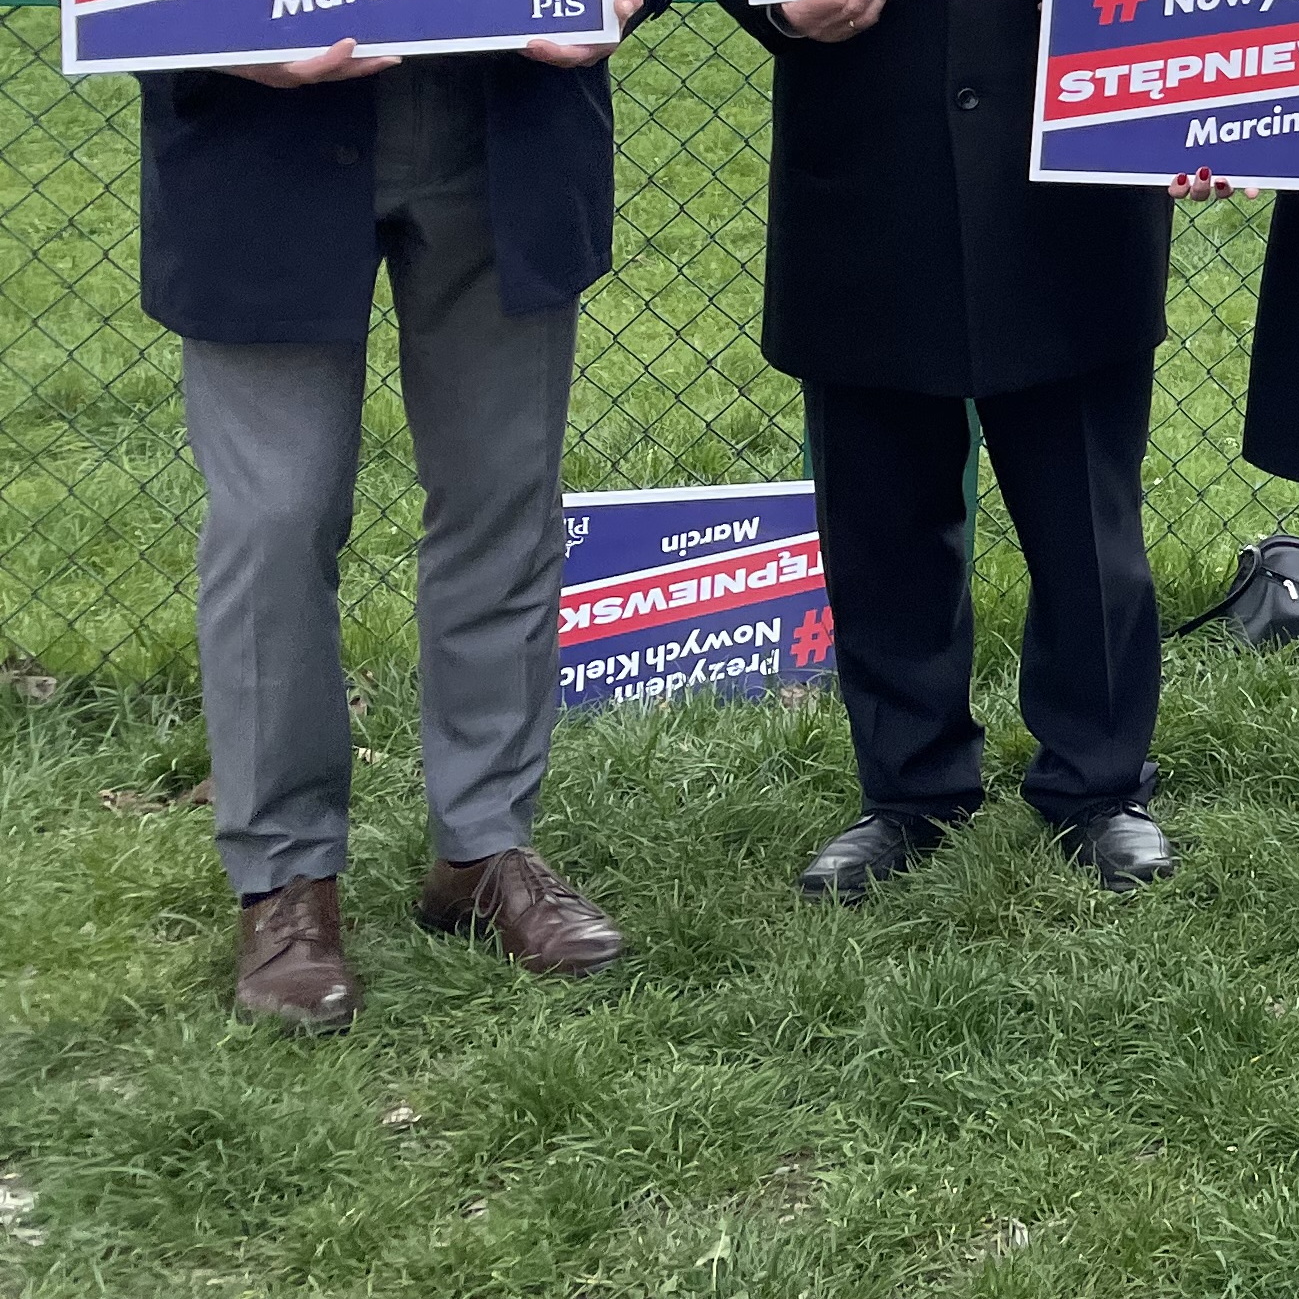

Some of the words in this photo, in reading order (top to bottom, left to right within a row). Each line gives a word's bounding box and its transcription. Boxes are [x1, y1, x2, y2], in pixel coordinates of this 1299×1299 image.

[661, 516, 760, 557] Marcin
[559, 551, 824, 634] TĘPNIEWSK
[645, 617, 781, 673] Nowych
[559, 650, 640, 693] Kielc
